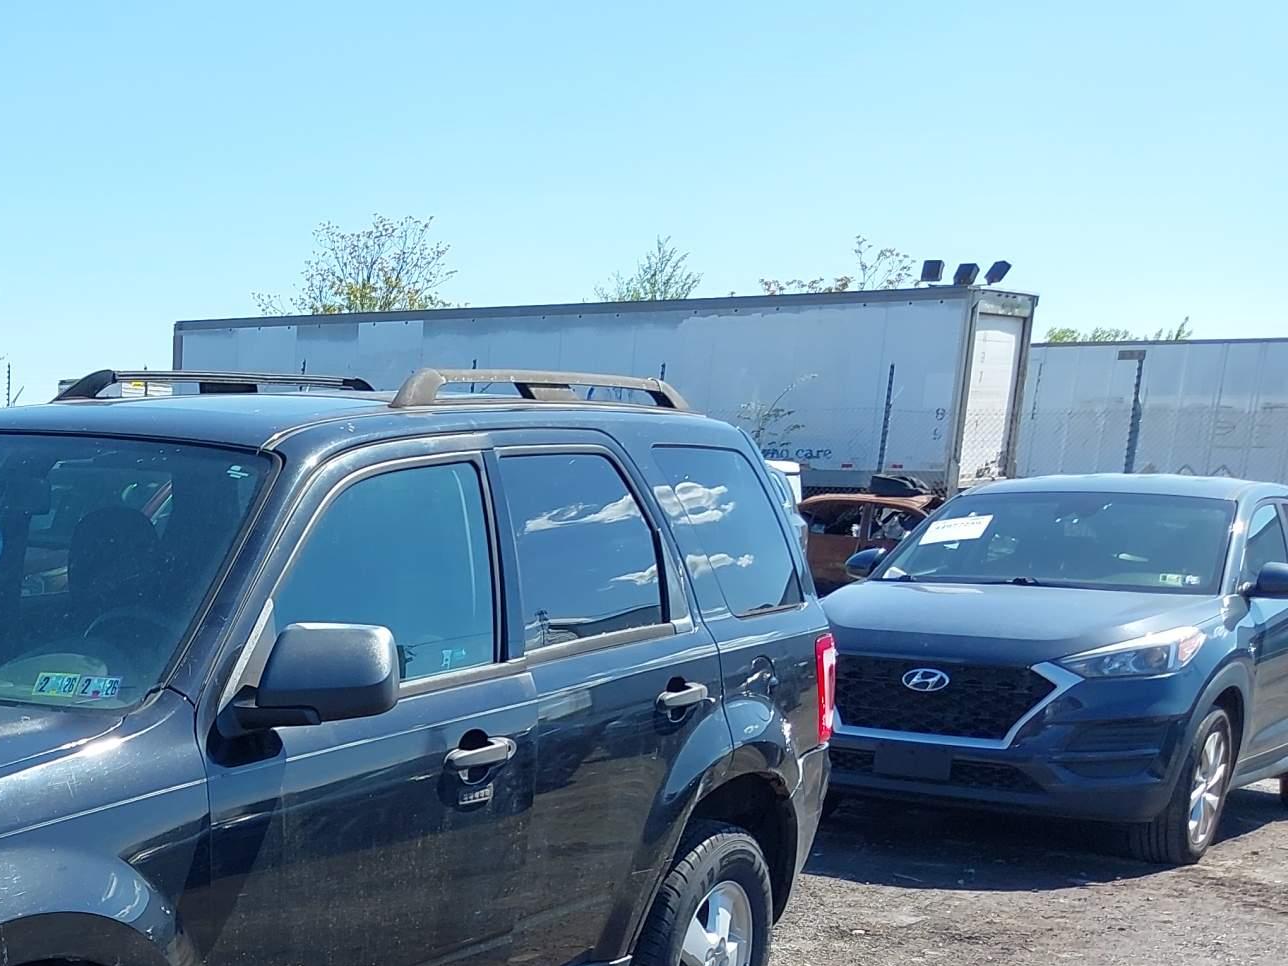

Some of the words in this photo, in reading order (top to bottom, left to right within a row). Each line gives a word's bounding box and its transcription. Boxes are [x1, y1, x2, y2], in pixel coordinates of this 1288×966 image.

[795, 447, 832, 460] care
[38, 676, 51, 693] 2
[81, 678, 92, 695] 2
[105, 679, 119, 696] 26
